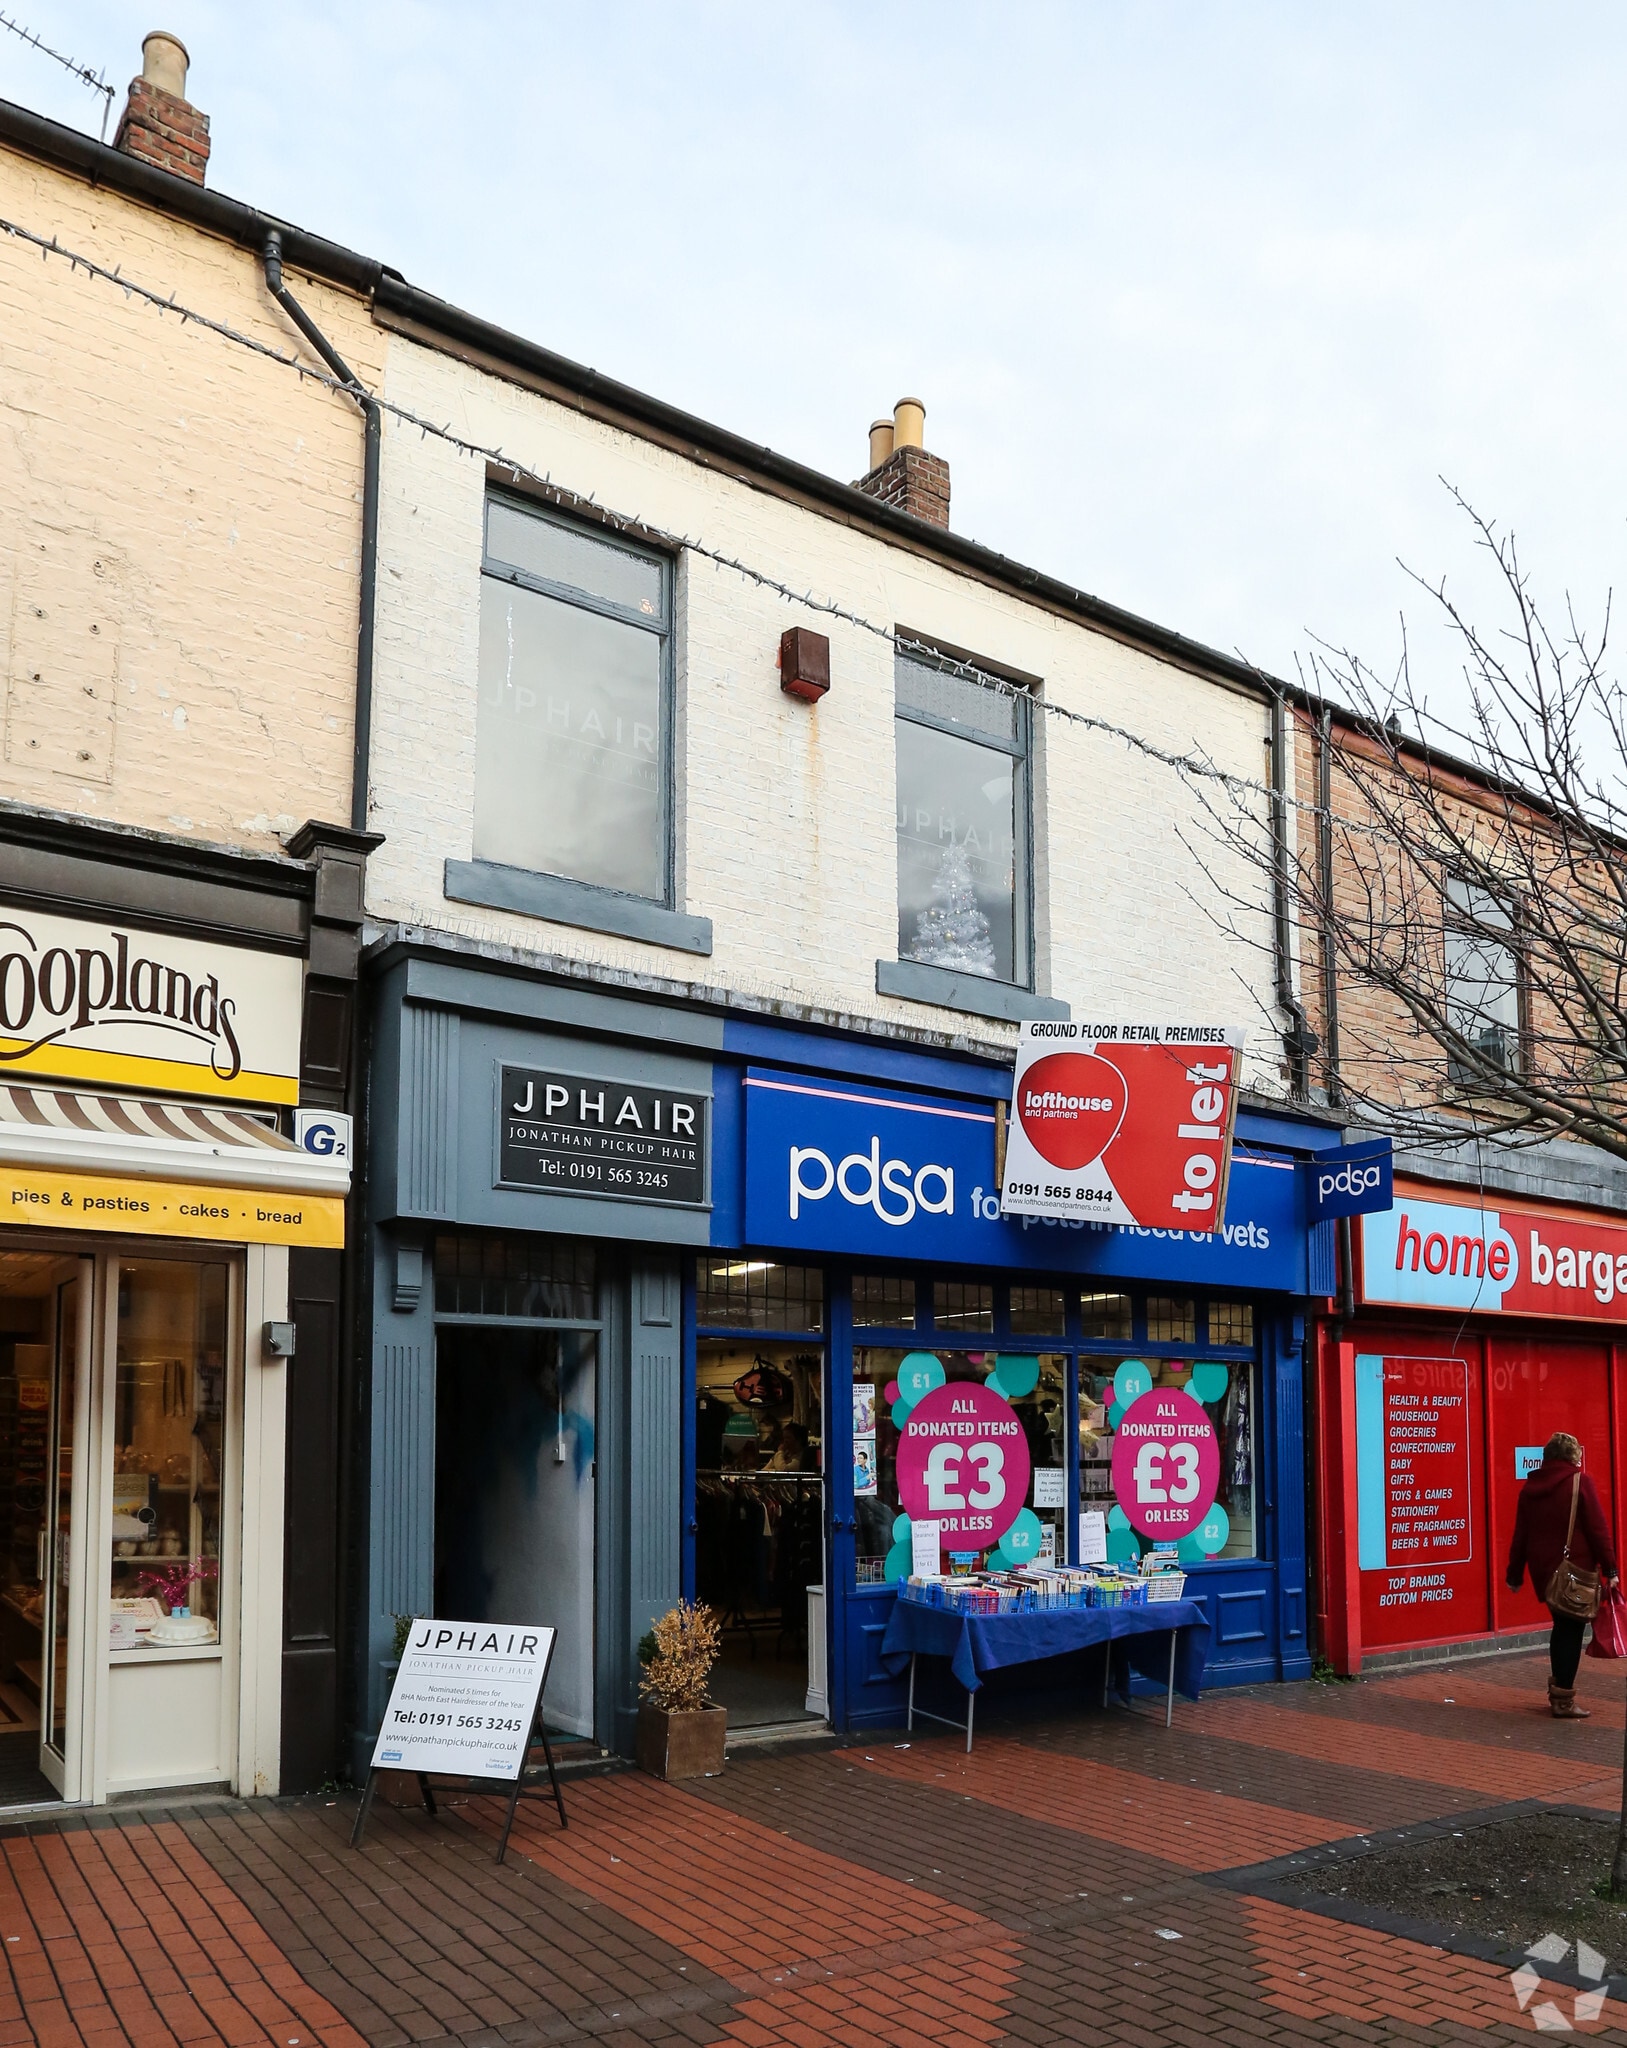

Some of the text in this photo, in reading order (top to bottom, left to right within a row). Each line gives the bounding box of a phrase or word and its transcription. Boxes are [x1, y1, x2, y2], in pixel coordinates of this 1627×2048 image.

[485, 679, 655, 753] JPHAIR
[1030, 1023, 1225, 1042] GROUND FLOOR RETAIL PREMISES
[513, 1081, 696, 1136] JPHAIR
[1025, 1091, 1113, 1112] lofthouse
[1177, 1062, 1228, 1140] let
[1025, 1108, 1078, 1120] and partners
[509, 1127, 696, 1160] JONATHAN PICKUP HAIR
[538, 1159, 669, 1188] Tel: 0191 565 3245
[1172, 1153, 1217, 1212] to
[1319, 1163, 1381, 1203] pdsa
[789, 1135, 954, 1226] pdsa
[970, 1186, 1009, 1221] fo
[1221, 1221, 1270, 1249] vets
[1008, 1182, 1113, 1202] 0191 565 8844
[11, 1189, 302, 1225] pies & pasties cakes bread
[1007, 1197, 1112, 1212] www.lofthouseandpartners.co.uk
[1395, 1213, 1510, 1281] home
[912, 1372, 930, 1389] £1
[1125, 1378, 1140, 1393] £1
[951, 1399, 977, 1414] ALL
[1389, 1395, 1462, 1407] HEALTH & BEAUTY
[1156, 1403, 1177, 1417] ALL
[1389, 1411, 1439, 1421] HOUSEHOLD
[908, 1421, 1018, 1437] DONATED ITEMS
[1121, 1423, 1211, 1438] DONATED ITEMS
[1389, 1426, 1437, 1438] GROCERIES
[21, 1438, 44, 1446] drink
[1390, 1442, 1456, 1453] CONFECTIONERY
[1390, 1459, 1412, 1469] BABY
[1523, 1456, 1544, 1469] hom
[923, 1441, 1006, 1511] £3
[1133, 1442, 1200, 1504] £3
[1390, 1474, 1415, 1485] GIFTS
[1391, 1488, 1453, 1501] TOYS & GAMES
[1145, 1508, 1190, 1523] OR LESS
[1391, 1505, 1439, 1517] STATIONERY
[940, 1515, 993, 1532] OR LESS
[1204, 1524, 1219, 1539] £2
[1391, 1519, 1465, 1533] FINE FRAGRANCES
[1012, 1531, 1029, 1547] £2
[1391, 1535, 1458, 1550] BEERS & WINES
[1388, 1574, 1446, 1590] TOP BRANDS
[1379, 1588, 1453, 1607] BOTTOM PRICES
[415, 1628, 539, 1656] JPHAIR
[409, 1660, 534, 1676] JONATHAN PICKUP HAIR
[428, 1685, 464, 1695] Nominated
[471, 1688, 490, 1696] times
[490, 1689, 501, 1697] for
[400, 1693, 415, 1701] BHA
[416, 1694, 435, 1702] North
[451, 1697, 488, 1706] Hairdresser
[489, 1698, 497, 1707] of
[498, 1699, 509, 1707] the
[510, 1701, 525, 1709] Year
[393, 1710, 521, 1732] Tel: 0191 565 3245
[386, 1733, 518, 1751] www.jonathanpickuphair.co.uk
